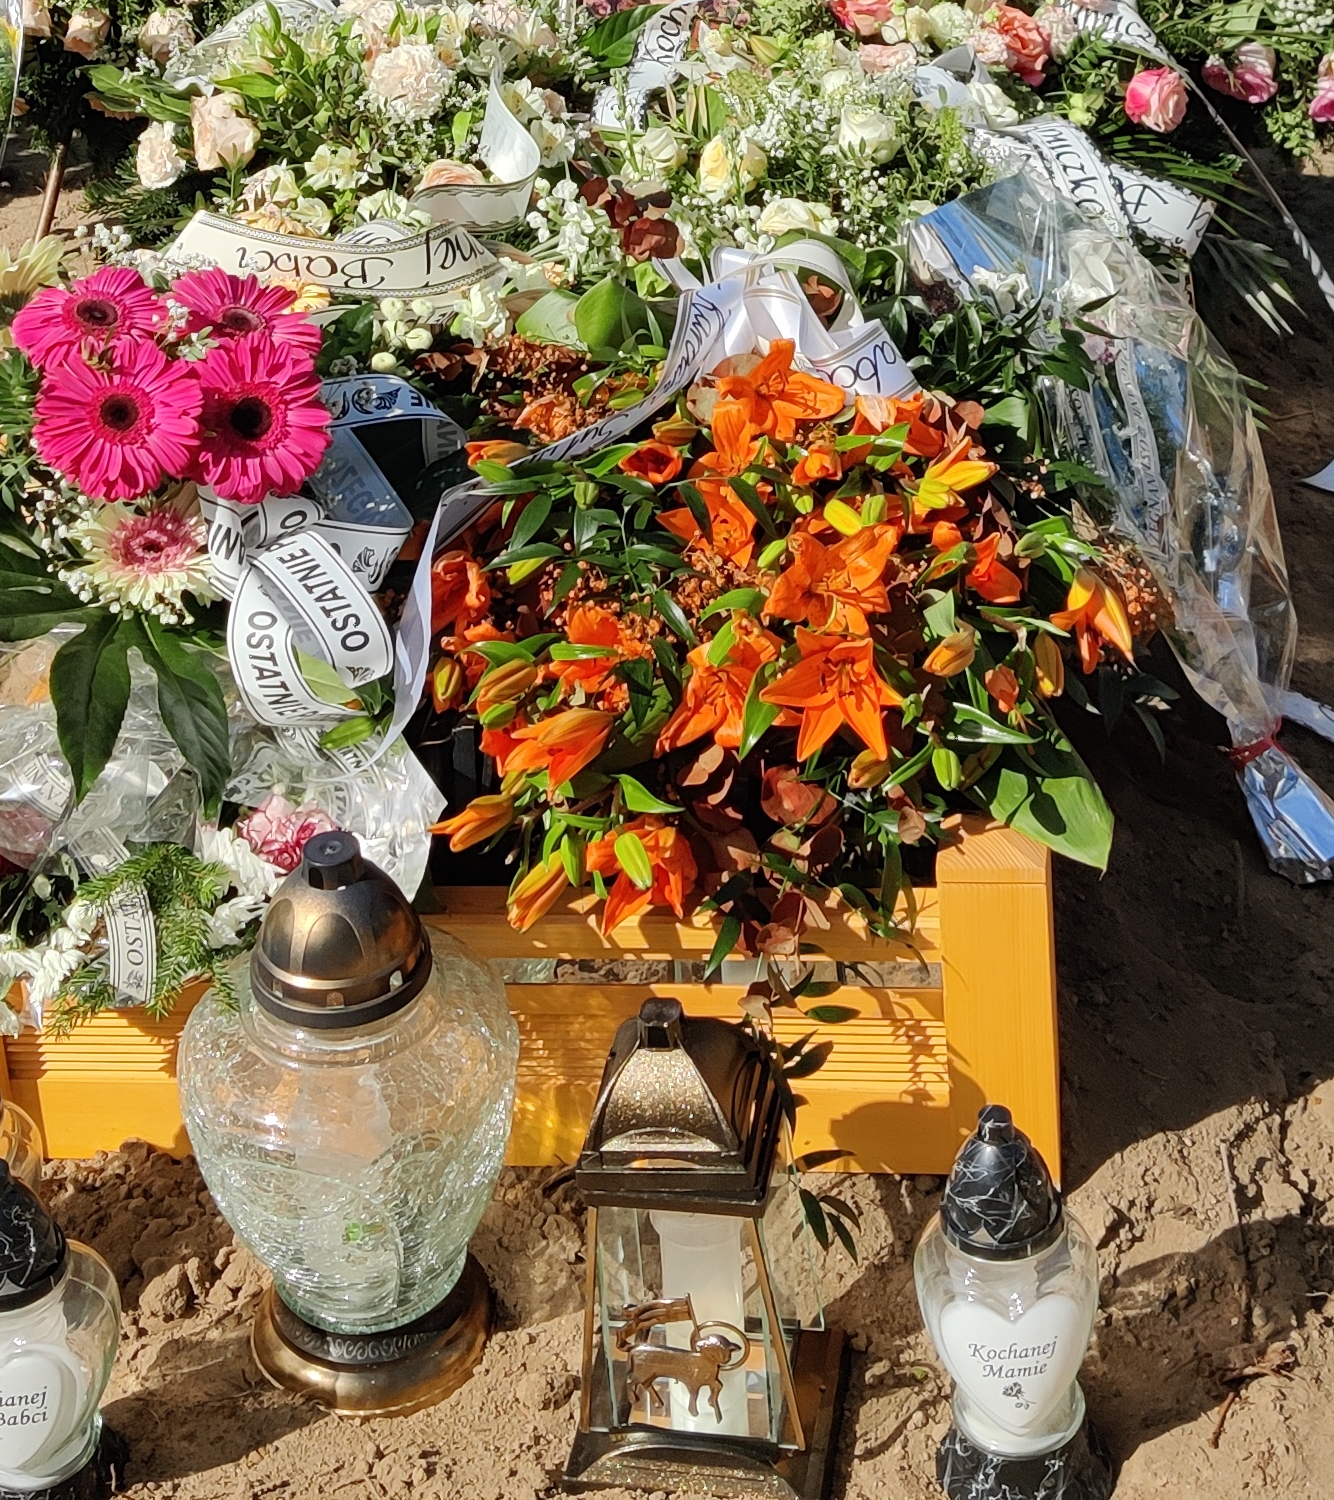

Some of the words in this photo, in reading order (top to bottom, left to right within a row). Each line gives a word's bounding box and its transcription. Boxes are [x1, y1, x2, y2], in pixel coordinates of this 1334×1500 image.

[278, 547, 370, 652] OSTATNIE
[246, 610, 311, 722] OSTATNIE
[968, 1335, 1059, 1363] Kochanej
[982, 1360, 1048, 1379] Mamie
